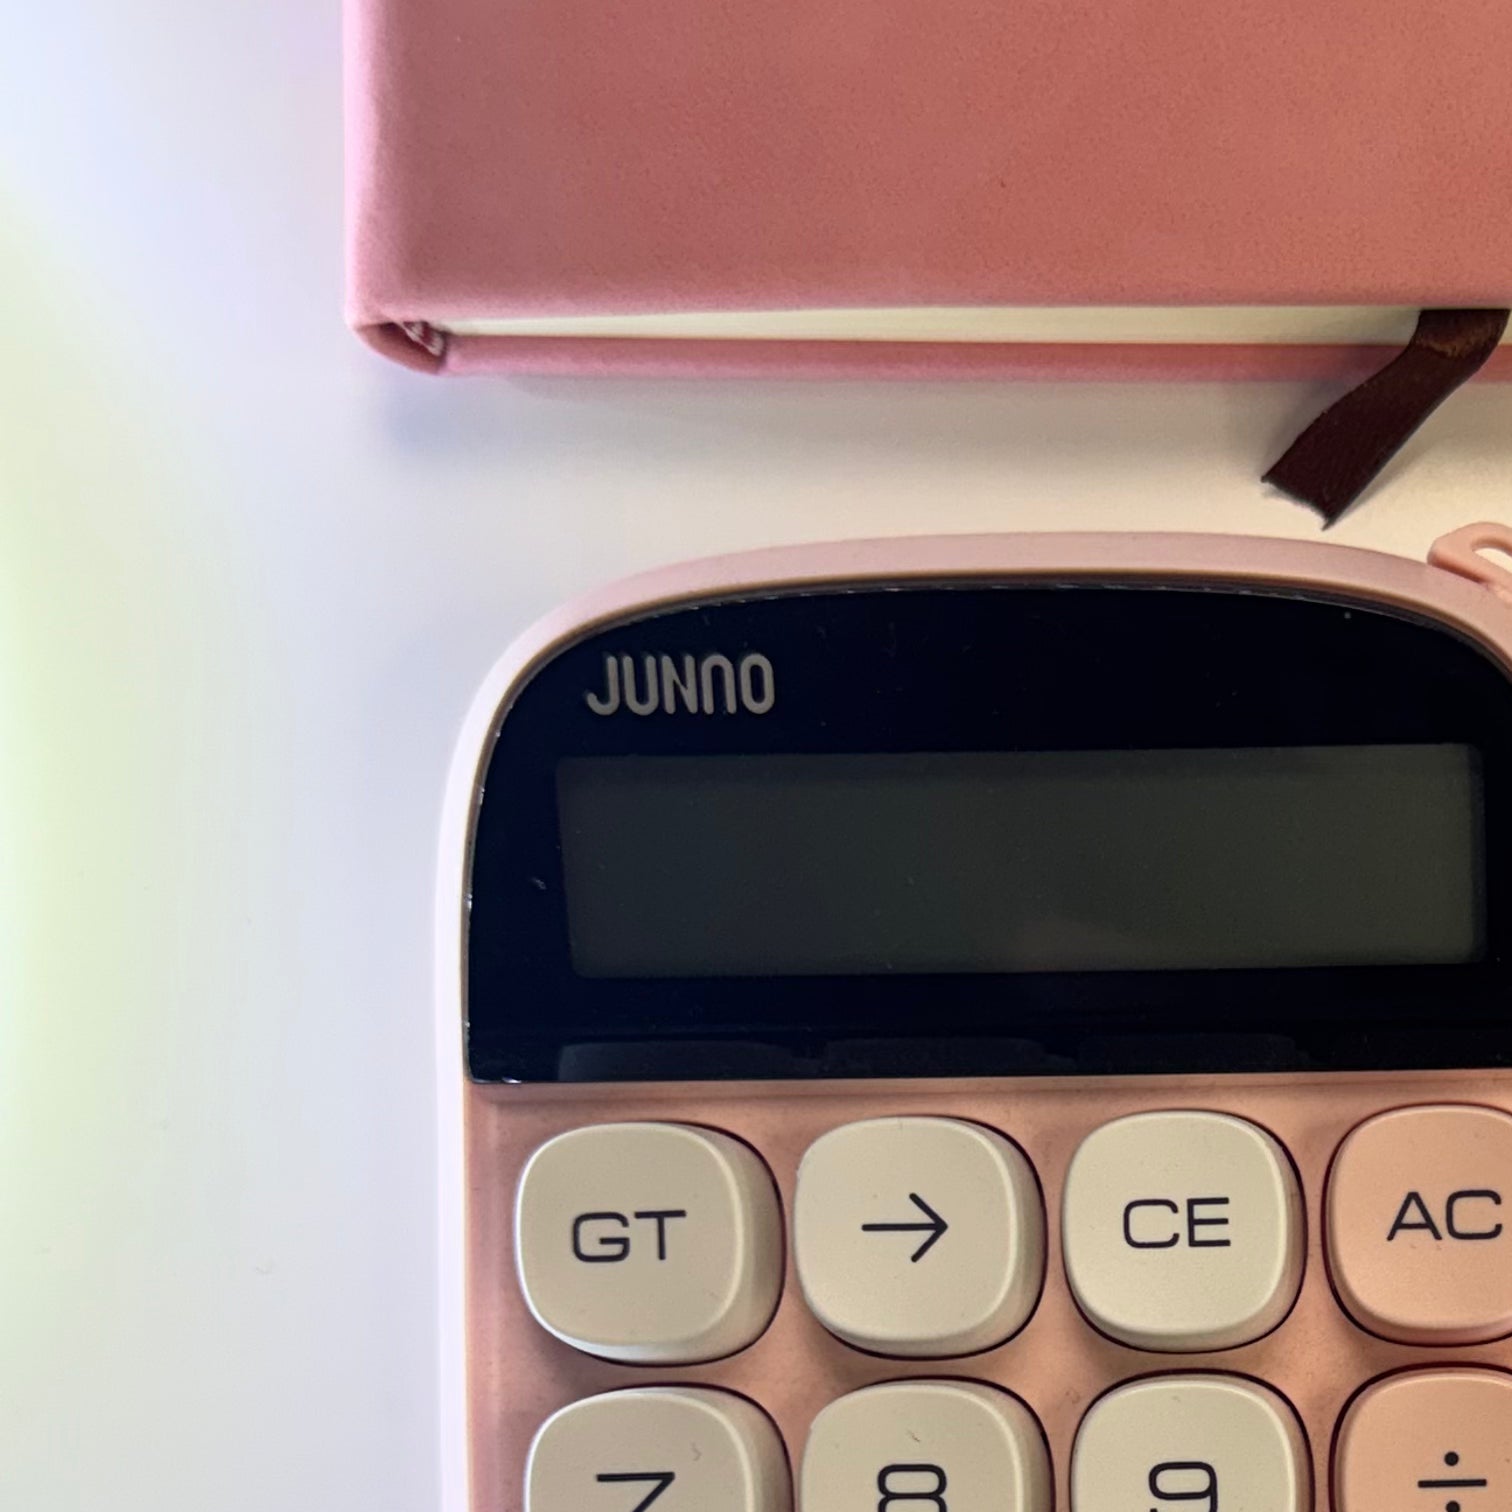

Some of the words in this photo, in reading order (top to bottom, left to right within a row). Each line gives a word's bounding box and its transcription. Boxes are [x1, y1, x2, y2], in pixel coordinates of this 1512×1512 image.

[571, 1209, 687, 1264] GT
[1122, 1196, 1232, 1249] CE
[1386, 1189, 1503, 1242] AC
